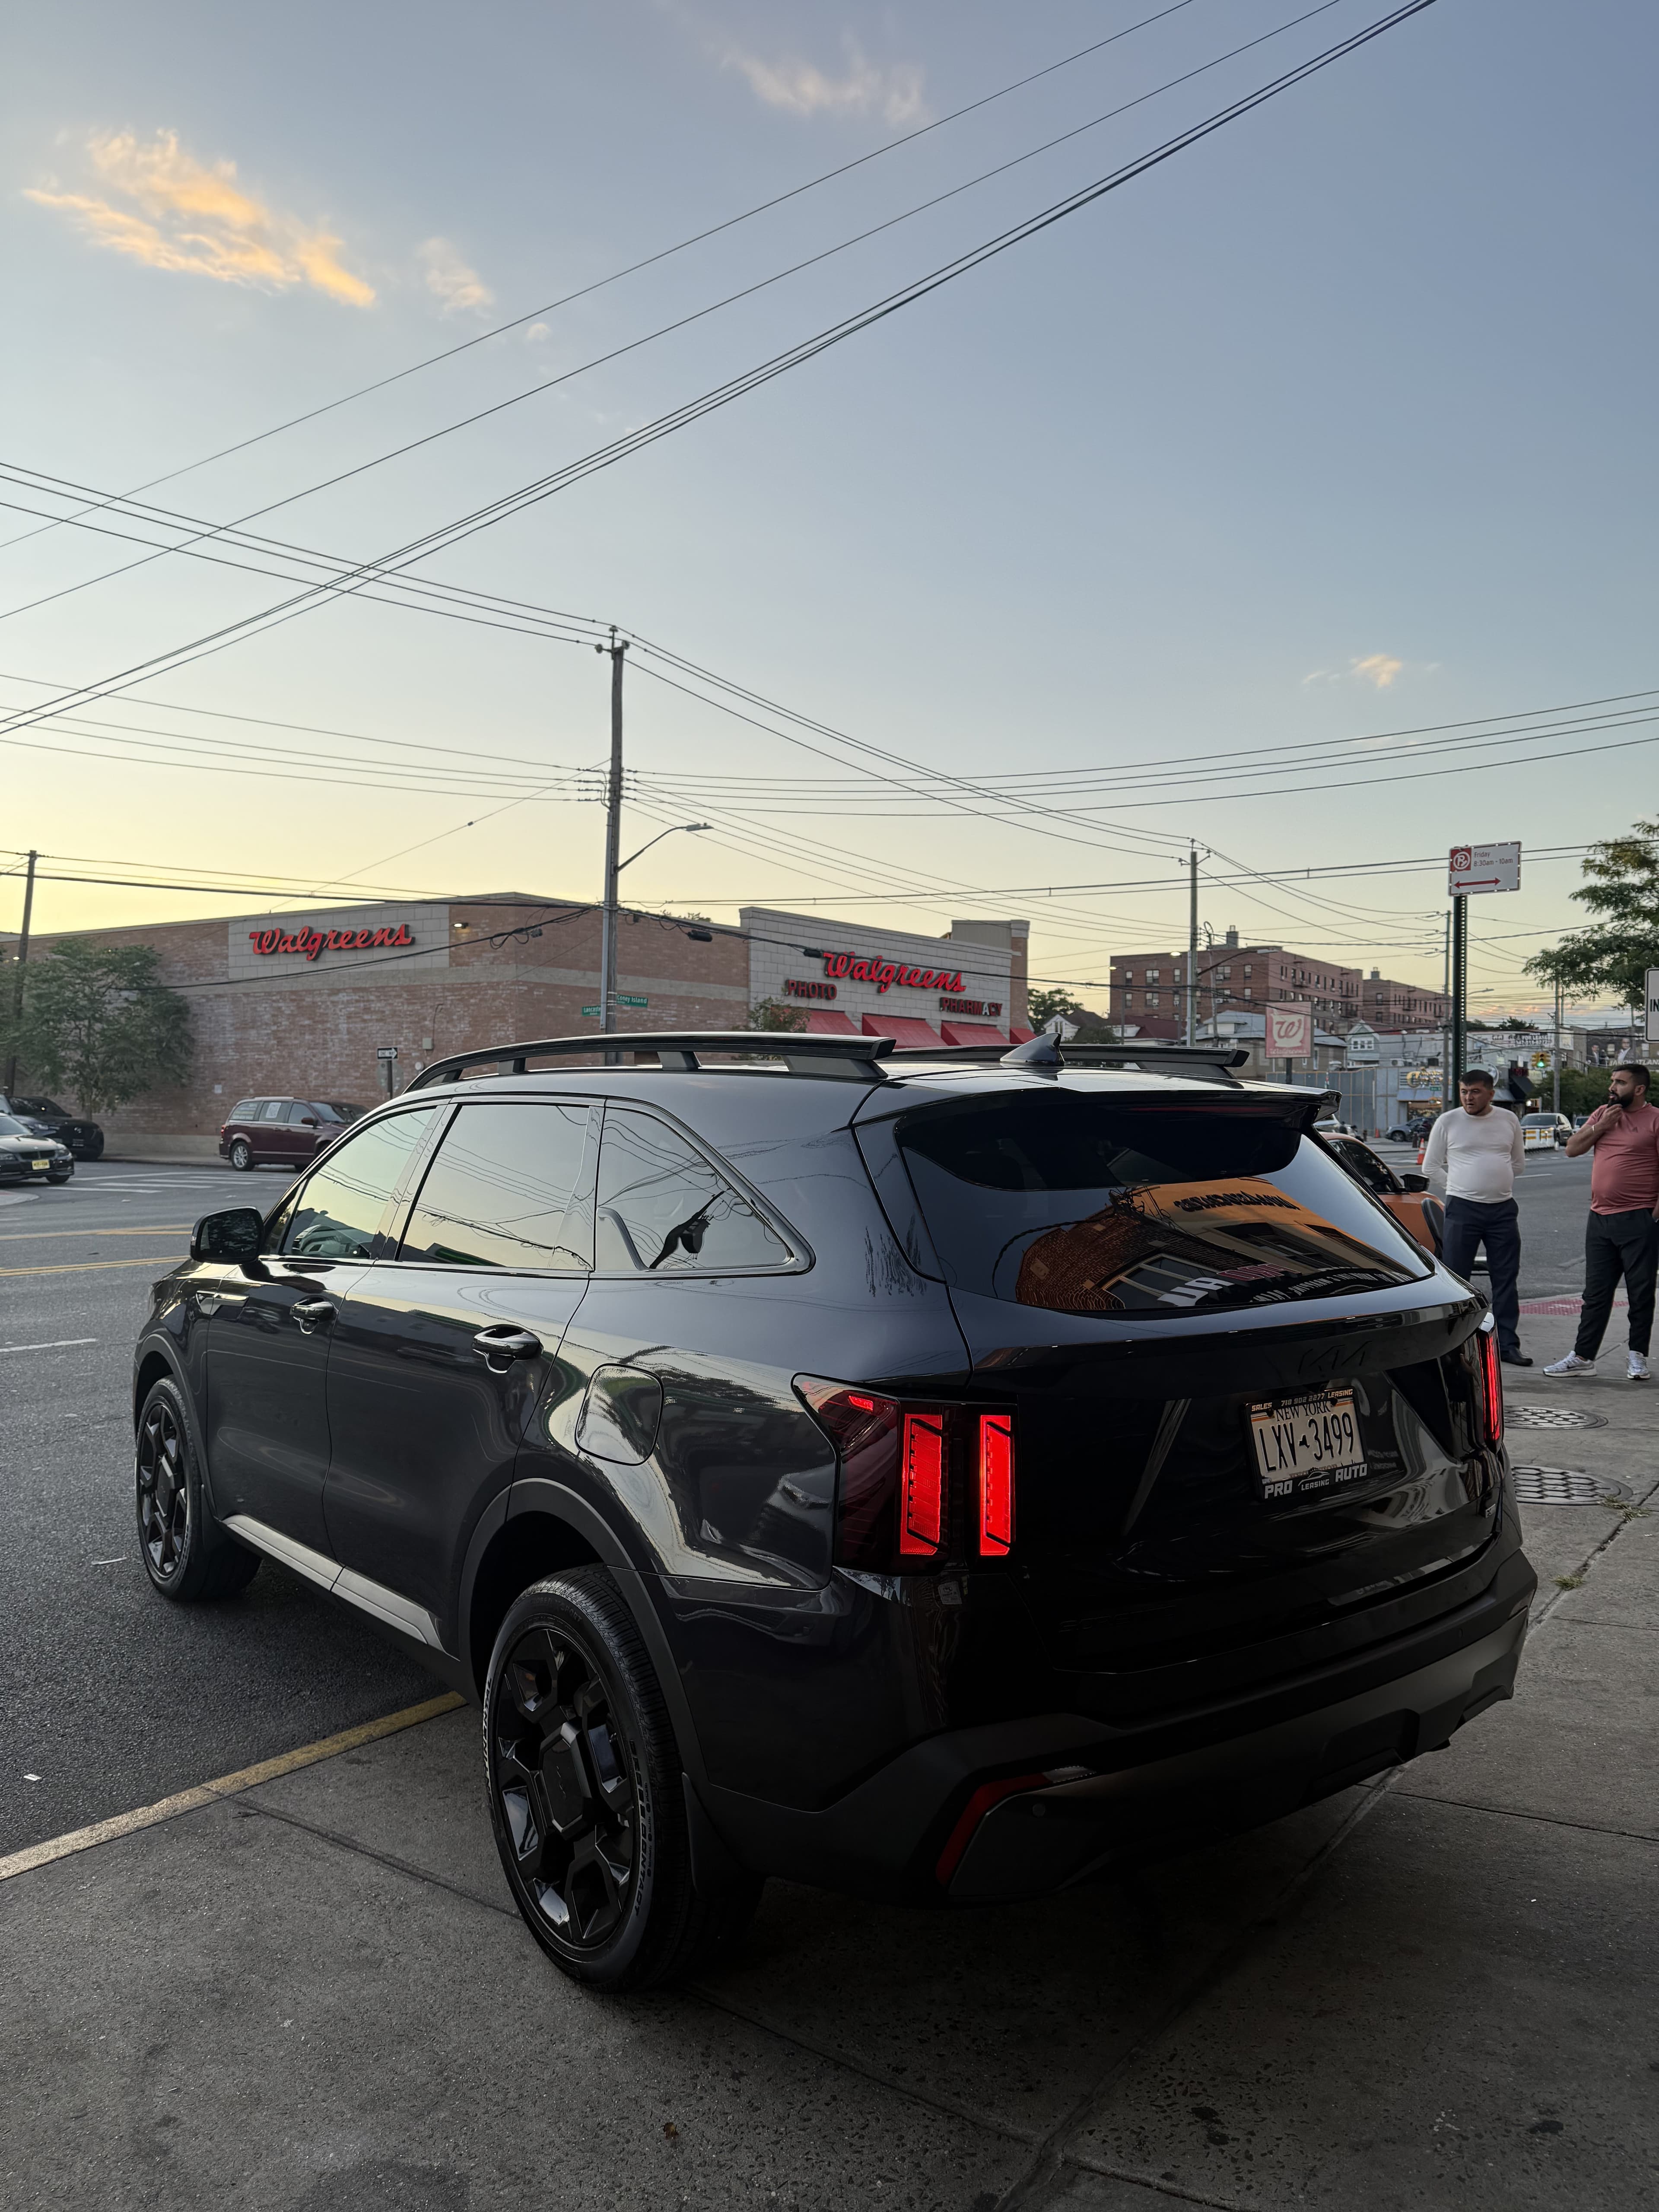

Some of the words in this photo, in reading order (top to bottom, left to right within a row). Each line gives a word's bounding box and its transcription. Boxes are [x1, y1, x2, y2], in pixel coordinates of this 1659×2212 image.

[249, 923, 413, 961] Walgreens
[823, 951, 966, 993] Walgreens
[617, 995, 630, 1003] Coney
[787, 979, 837, 1000] PHOTO
[941, 997, 1003, 1017] PHARMACY
[1252, 1402, 1272, 1411] SALES
[1294, 1396, 1307, 1405] 902
[1309, 1393, 1325, 1402] 2277
[1328, 1389, 1353, 1399] LEASING
[1276, 1405, 1300, 1422] NEW
[1302, 1401, 1331, 1417] YORK
[1264, 1480, 1293, 1499] PRO
[1335, 1463, 1367, 1482] AUTO
[1301, 1479, 1329, 1491] LEASING
